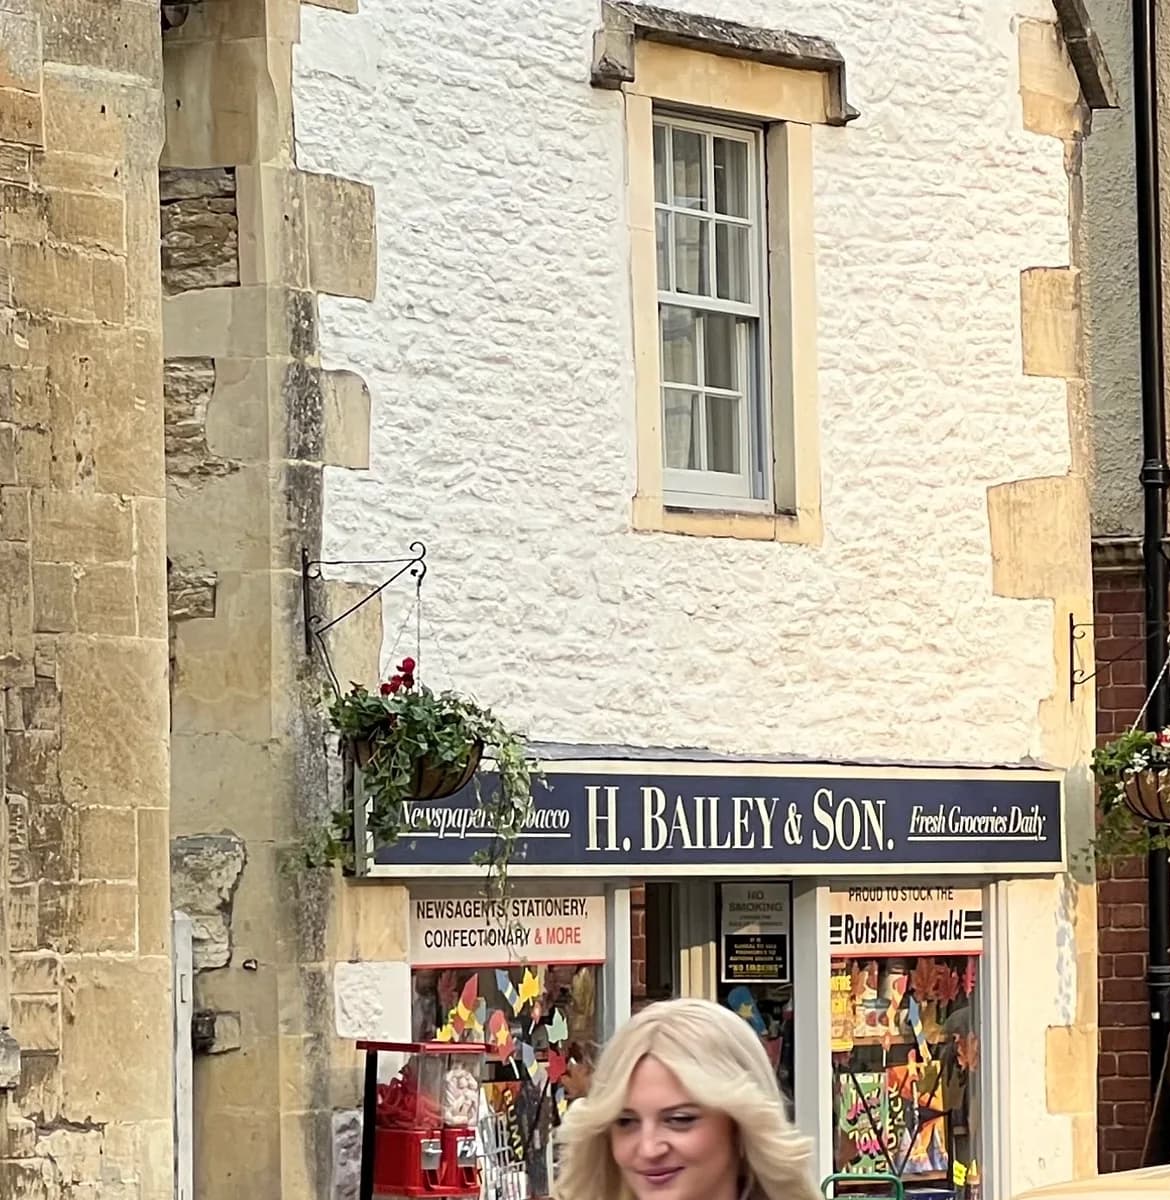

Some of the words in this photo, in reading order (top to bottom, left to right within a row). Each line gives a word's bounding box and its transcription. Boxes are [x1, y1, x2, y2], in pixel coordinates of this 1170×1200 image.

[584, 786, 631, 852] H.
[640, 786, 779, 852] BAILEY
[783, 802, 803, 846] &
[812, 787, 895, 851] SON.
[909, 804, 946, 834] Fresh
[948, 805, 1007, 834] Groceries
[1009, 804, 1046, 841] Daily
[848, 886, 883, 902] PROUD
[885, 886, 899, 901] TO
[901, 886, 933, 901] STOCK
[935, 886, 954, 901] THE
[512, 898, 588, 918] STATIONERY,
[728, 902, 784, 912] SMOKING
[424, 928, 531, 948] CONFECTIONARY
[534, 927, 542, 945] &
[546, 926, 582, 945] MORE
[844, 911, 908, 945] Rutshire
[912, 909, 963, 942] Herald
